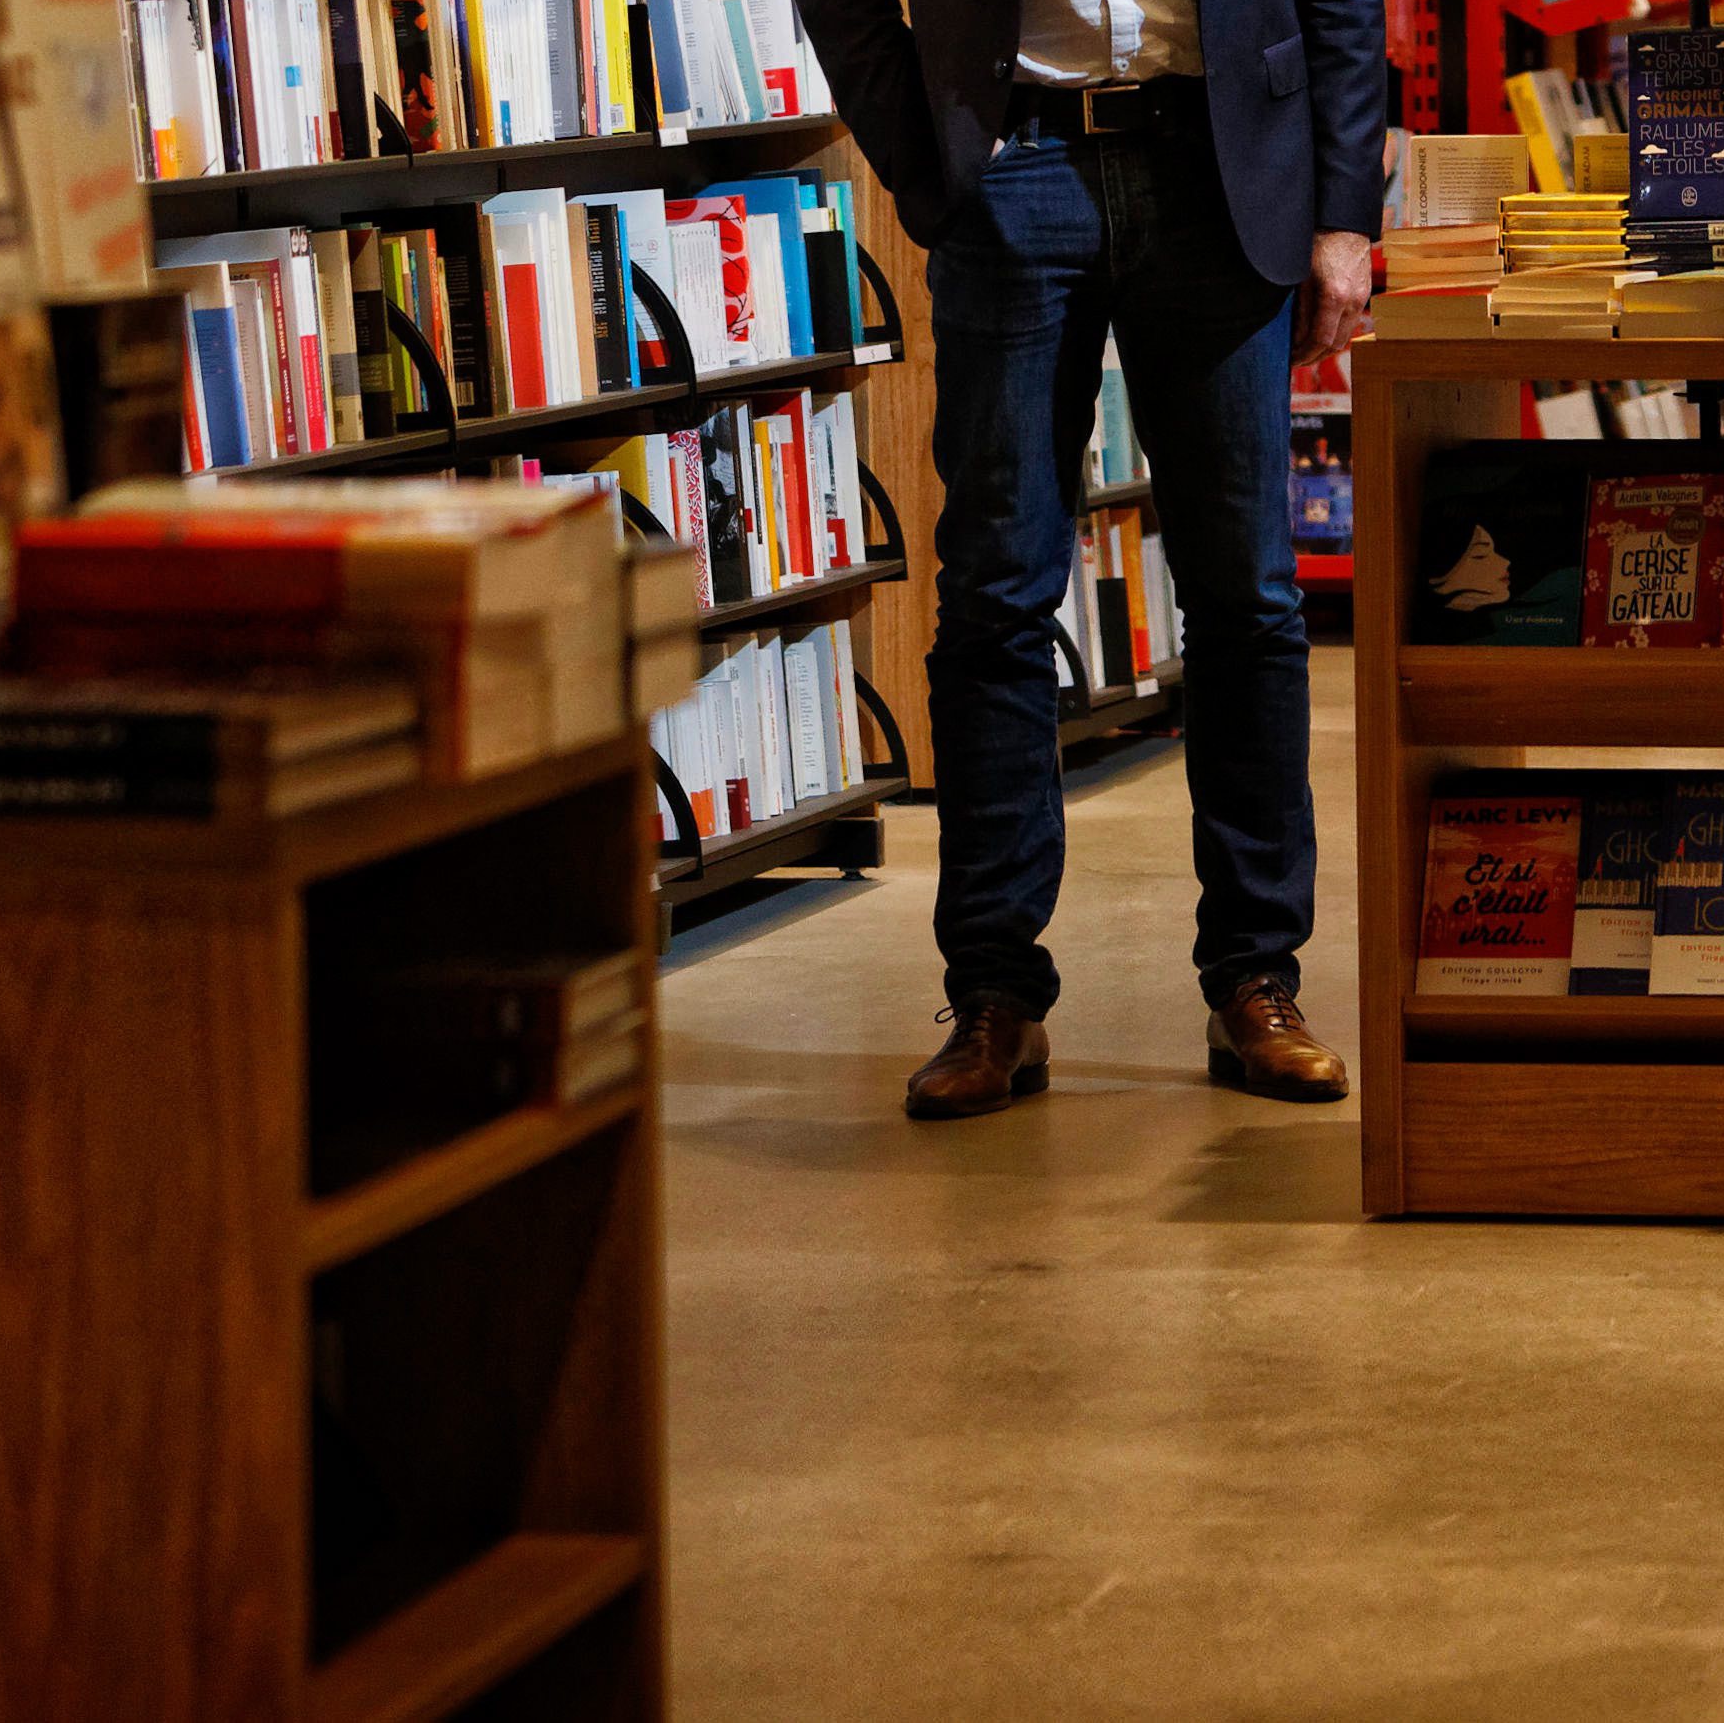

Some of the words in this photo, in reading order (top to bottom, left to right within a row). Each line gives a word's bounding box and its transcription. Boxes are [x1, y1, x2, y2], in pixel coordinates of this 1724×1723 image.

[1658, 36, 1673, 53] IL
[1679, 34, 1715, 52] EST
[1655, 52, 1719, 70] GRAND
[1640, 70, 1705, 88] TEMPS
[1654, 89, 1721, 103] VIRGINIE
[1671, 140, 1706, 158] LES
[1418, 146, 1427, 211] CORDONNIER
[1618, 490, 1653, 505] Aurélie
[1655, 489, 1699, 503] Valognes
[1649, 533, 1665, 549] LA
[1620, 547, 1692, 577] CERISE
[1638, 577, 1663, 592] SUR
[1664, 577, 1678, 590] LE
[1612, 590, 1693, 622] GÂTEAU
[1442, 806, 1511, 825] MARC
[1514, 805, 1573, 824] LEVY
[1464, 852, 1502, 885] Et
[1505, 856, 1538, 882] si
